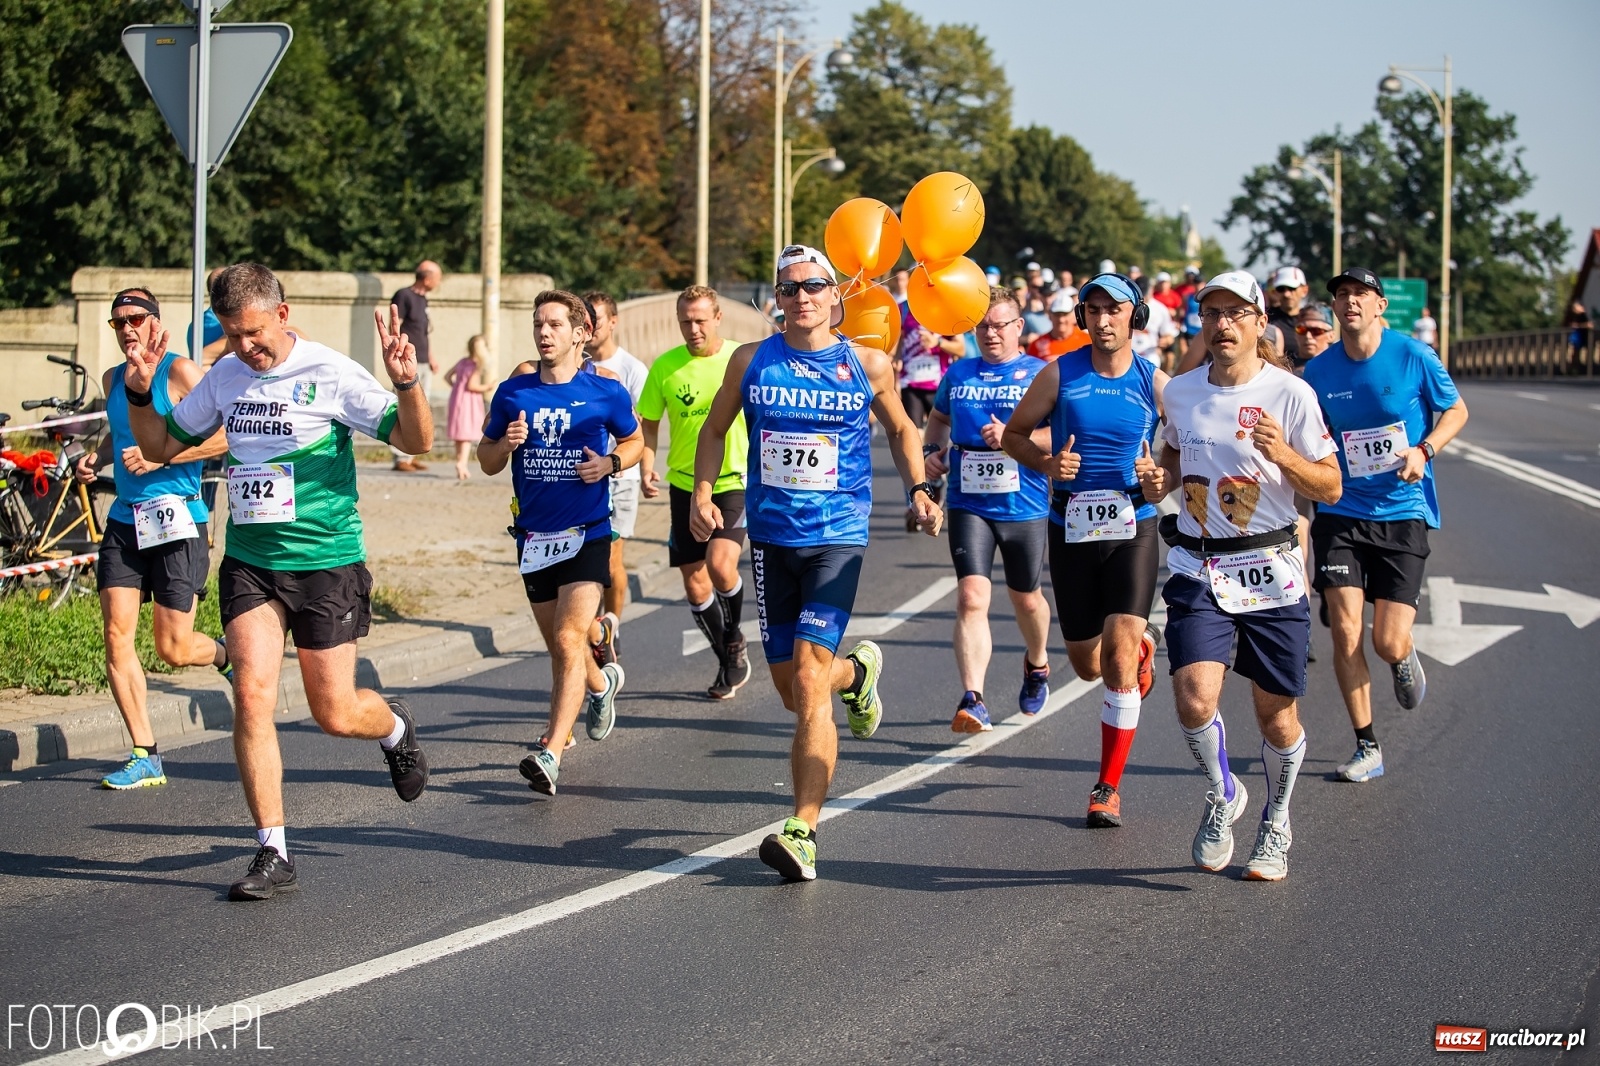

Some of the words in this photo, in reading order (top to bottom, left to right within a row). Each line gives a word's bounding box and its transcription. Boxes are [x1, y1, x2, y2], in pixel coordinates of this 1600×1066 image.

[749, 384, 866, 411] RUNNERS
[232, 401, 268, 417] TEAM
[268, 401, 289, 418] OF
[817, 413, 844, 422] TEAM
[225, 415, 293, 436] RUNNERS
[523, 448, 535, 457] 2nd
[535, 449, 563, 458] WIZZ
[564, 449, 583, 458] AIR
[782, 447, 819, 468] 376
[1363, 439, 1393, 457] 189
[976, 462, 1004, 477] 398
[241, 479, 275, 500] 242
[156, 507, 175, 525] 99
[1085, 503, 1118, 522] 198
[1237, 565, 1275, 588] 105
[753, 547, 770, 643] RUNNERS
[1273, 756, 1295, 805] Kalenji
